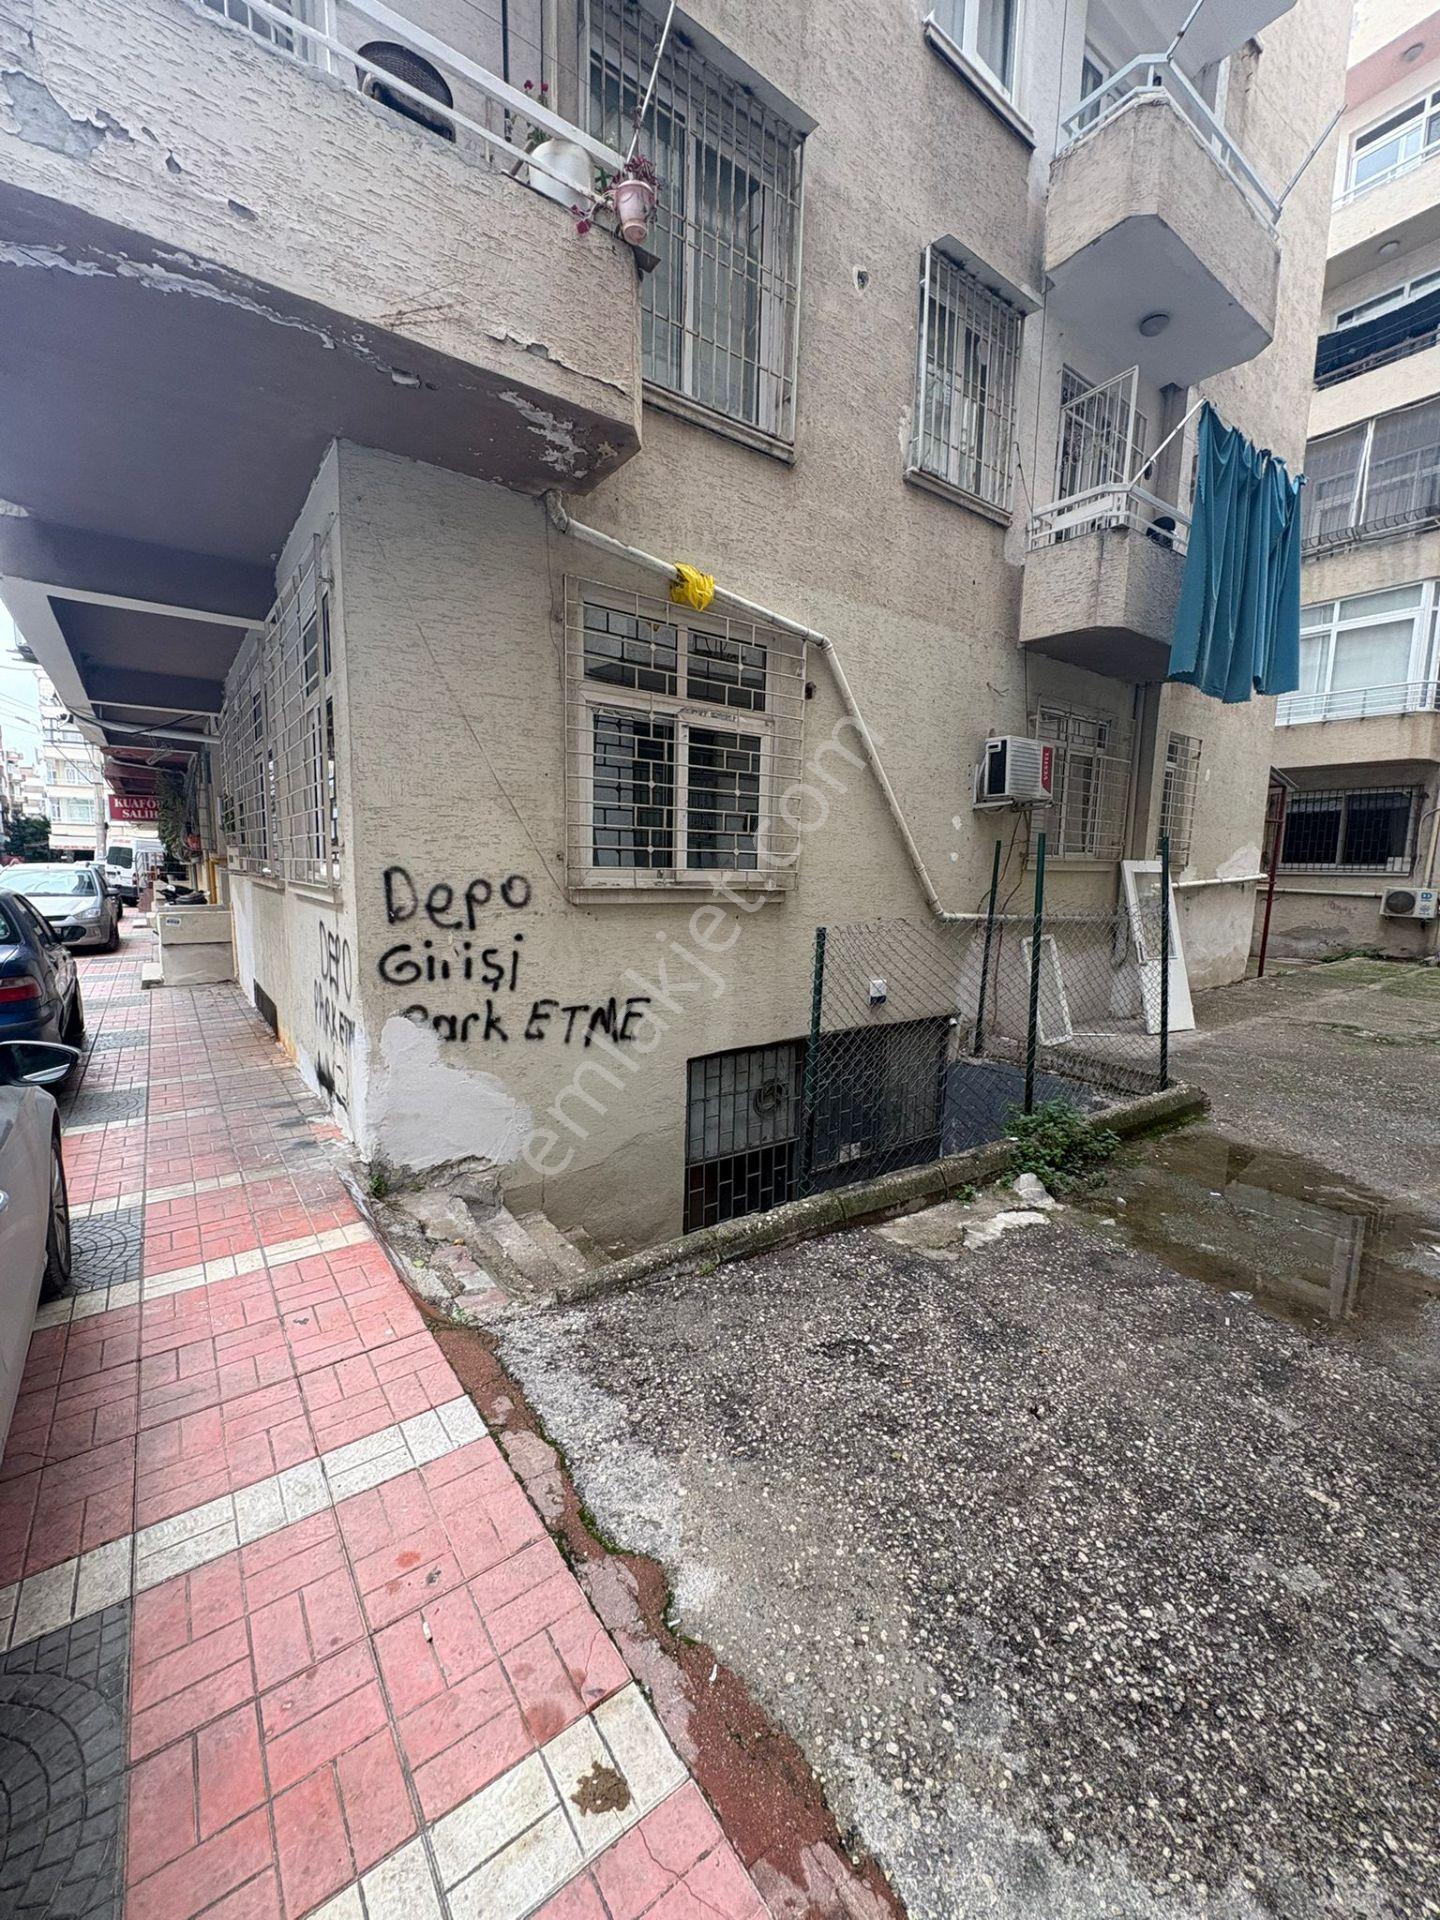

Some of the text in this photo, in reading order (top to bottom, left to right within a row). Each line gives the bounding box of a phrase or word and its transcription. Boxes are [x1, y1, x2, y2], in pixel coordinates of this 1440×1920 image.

[383, 866, 532, 931] Depo
[319, 919, 352, 1002] DEPO
[524, 997, 651, 1048] ETME
